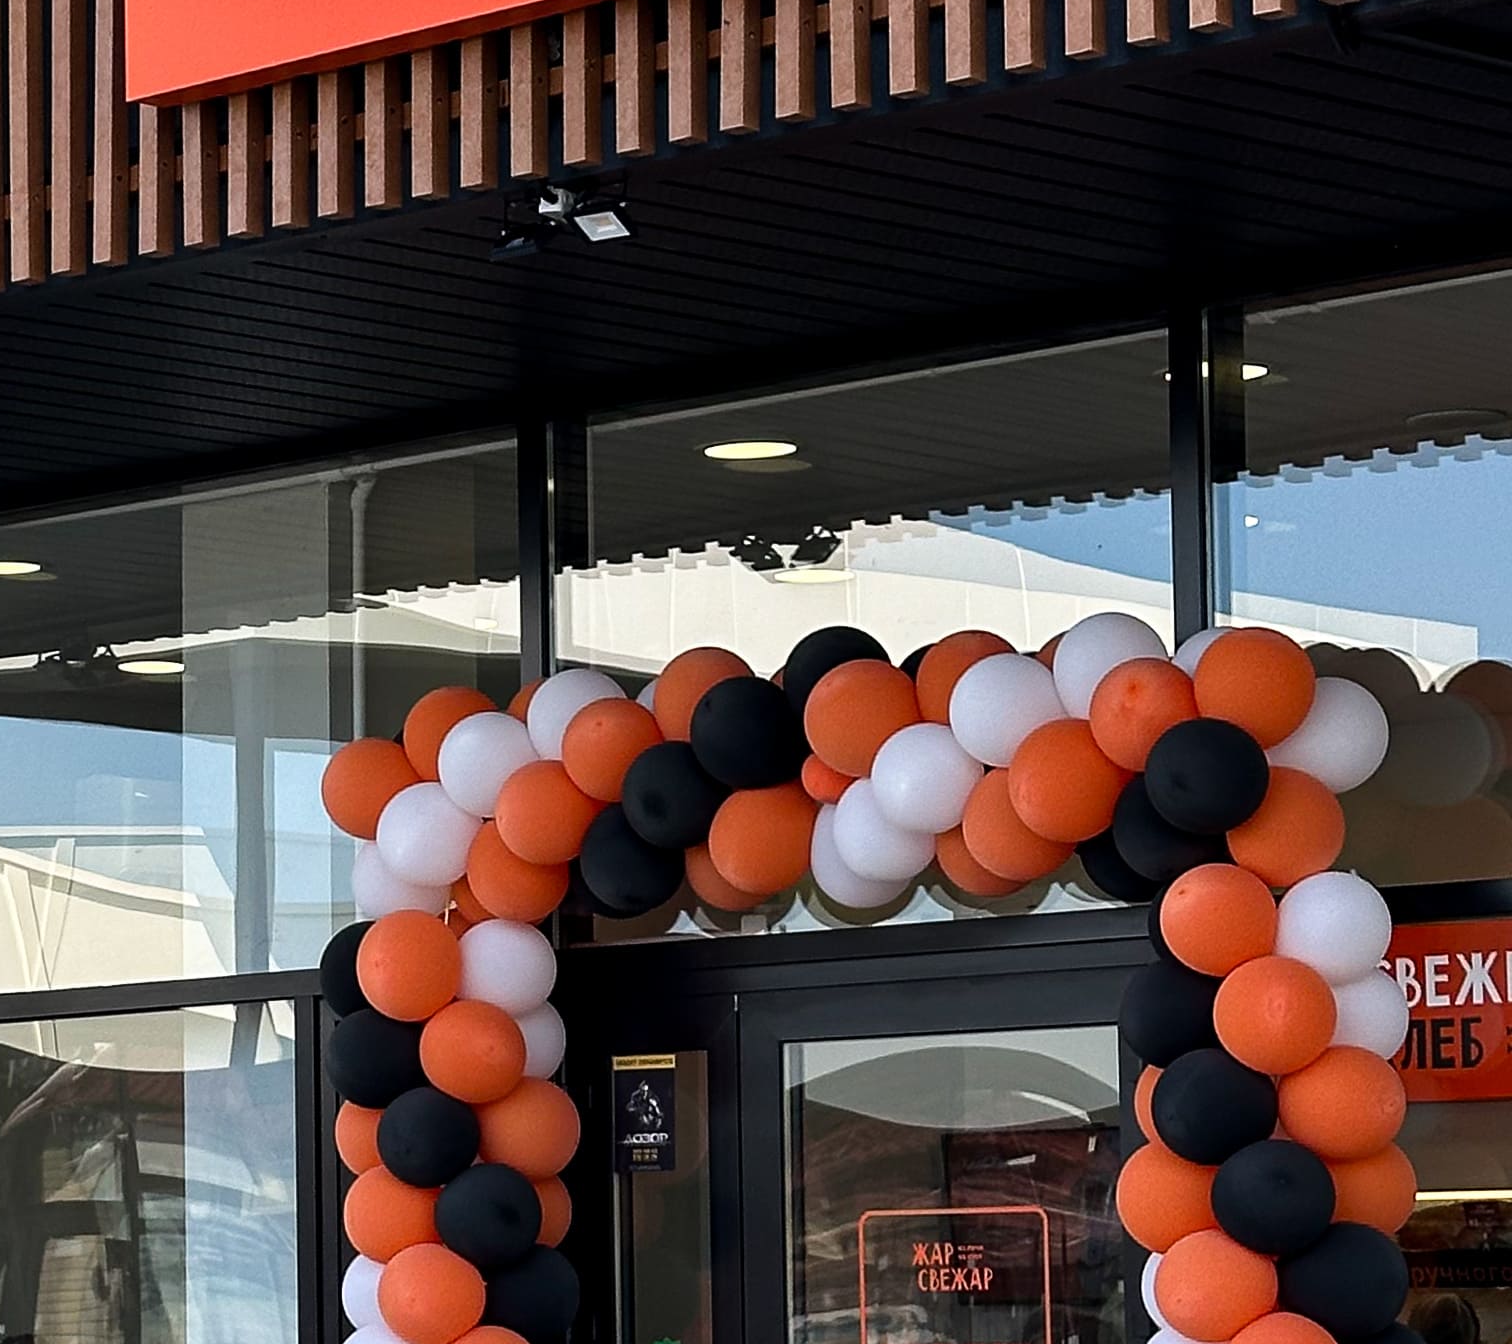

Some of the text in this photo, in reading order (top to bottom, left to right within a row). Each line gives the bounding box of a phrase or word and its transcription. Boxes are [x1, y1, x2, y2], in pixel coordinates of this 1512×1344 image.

[1377, 950, 1512, 1008] ВЕЖ
[1391, 1015, 1484, 1070] ЛЕБ
[912, 1242, 955, 1266] ЖАР
[917, 1266, 994, 1292] СВЕЖАР
